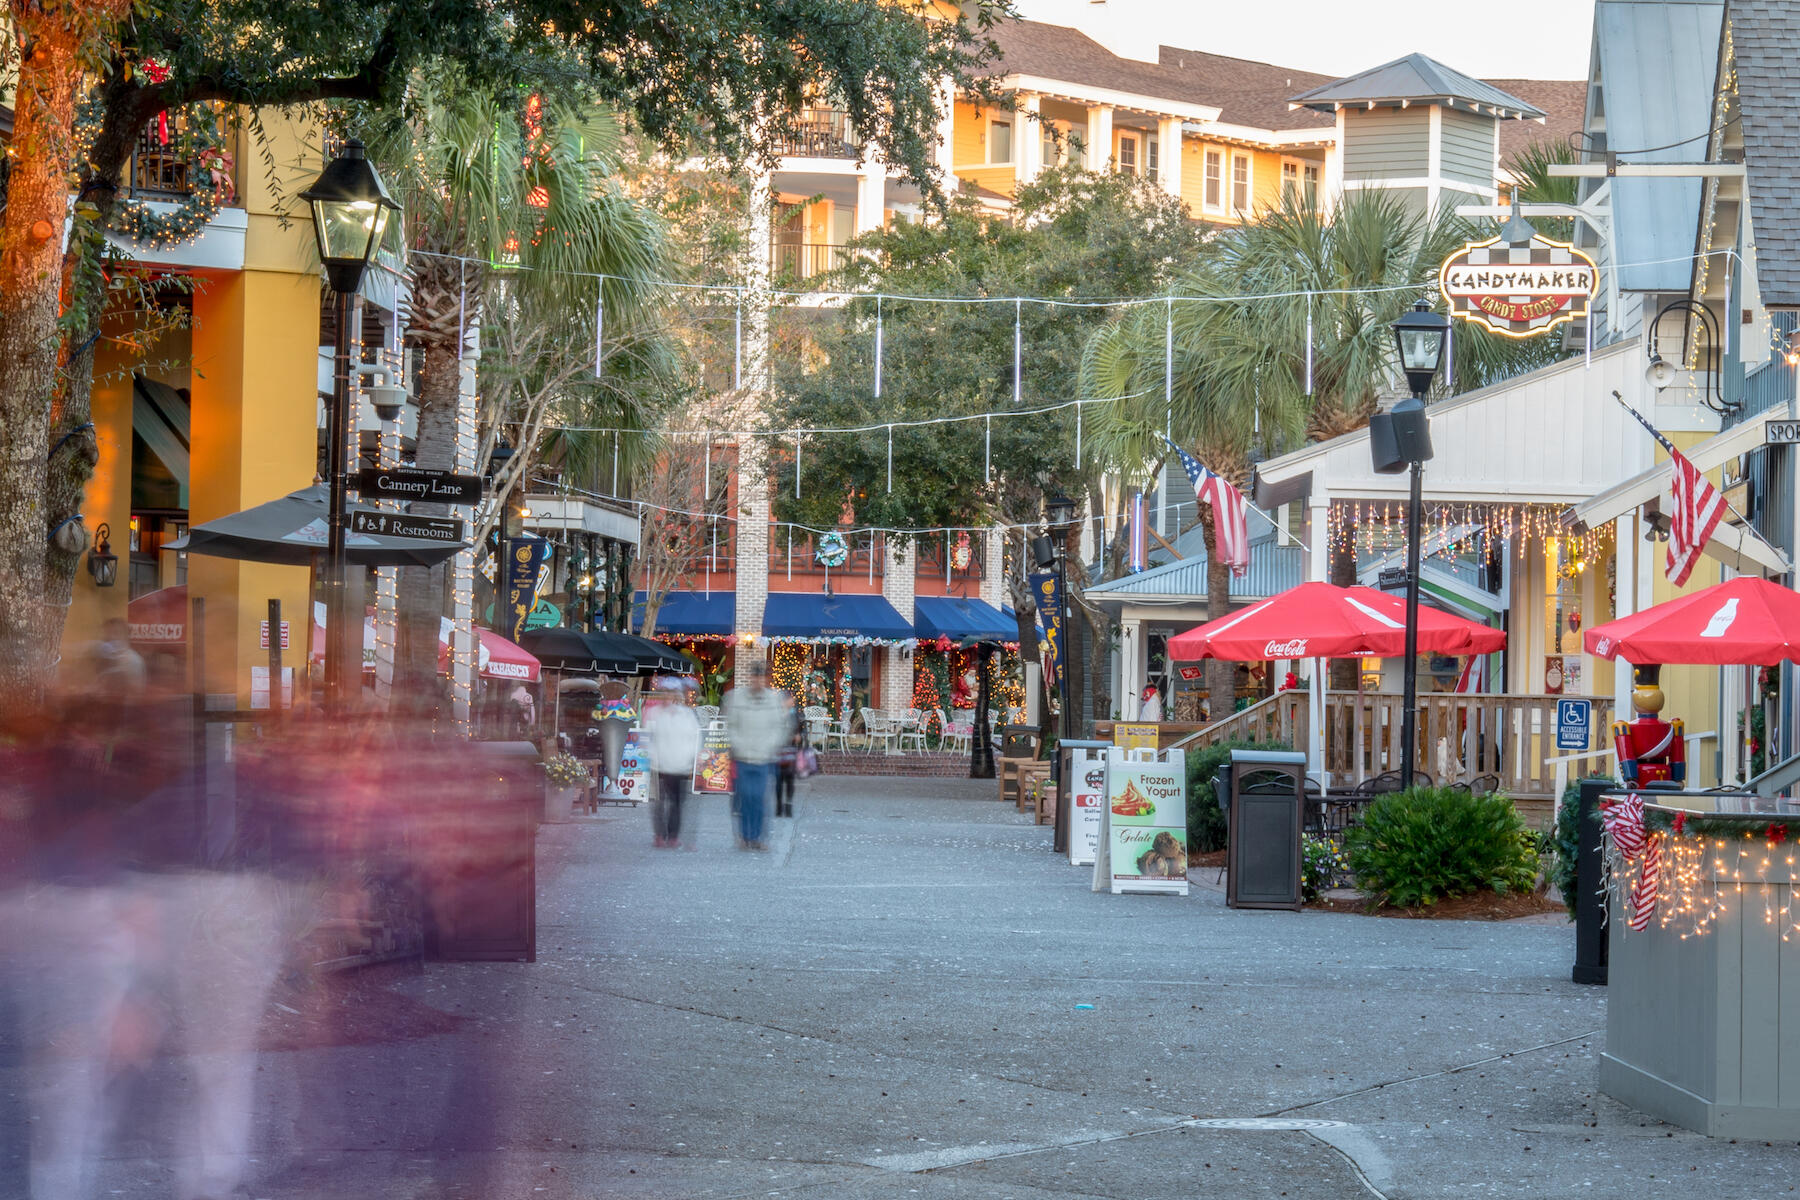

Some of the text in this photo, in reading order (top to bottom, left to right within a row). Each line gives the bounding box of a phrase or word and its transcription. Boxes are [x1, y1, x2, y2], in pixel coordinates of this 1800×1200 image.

[1451, 272, 1589, 289] CANDYMAKER
[1480, 296, 1559, 319] CANDY STORE
[377, 476, 462, 498] Cannery Lane
[392, 521, 454, 539] Restrooms
[488, 662, 530, 678] TABASCO
[1560, 726, 1587, 734] ACCESSIBLE
[1140, 774, 1175, 785] Frozen
[1146, 786, 1181, 799] Yogurt
